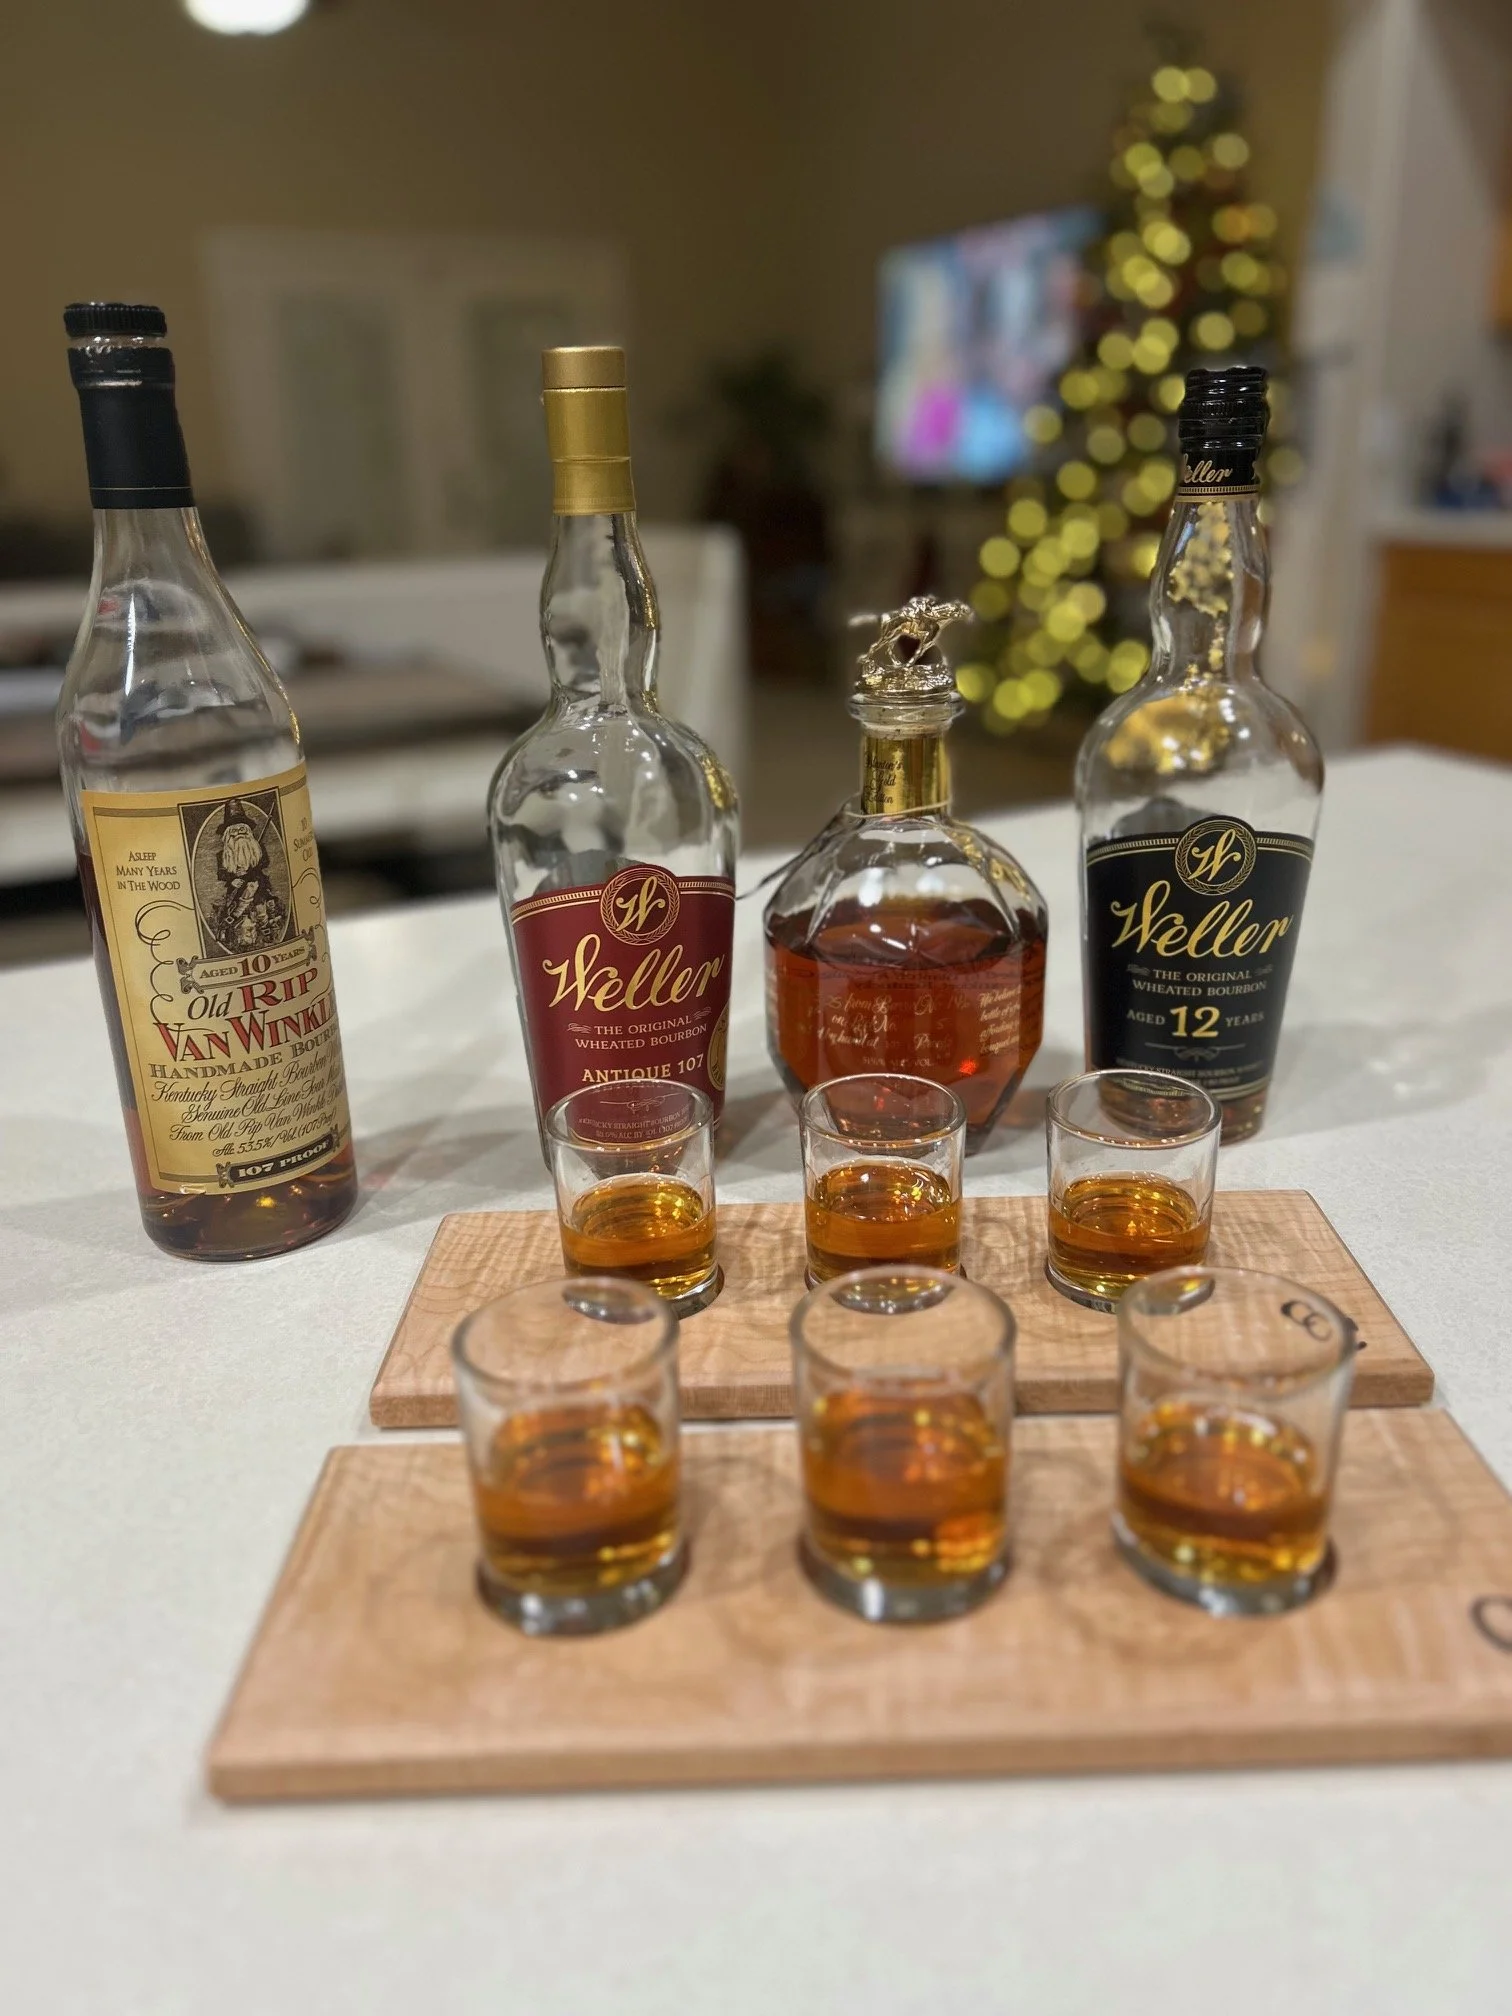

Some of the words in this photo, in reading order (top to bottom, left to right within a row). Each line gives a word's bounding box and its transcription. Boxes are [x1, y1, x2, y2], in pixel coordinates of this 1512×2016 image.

[1182, 453, 1233, 483] eller
[116, 865, 144, 877] MANY
[146, 865, 178, 877] YEARS
[128, 851, 157, 862] ASLEEP
[148, 880, 181, 891] WOOD
[1110, 879, 1294, 959] Weller
[200, 966, 239, 979] AGED
[237, 953, 272, 978] 10
[270, 946, 306, 965] YEARS
[542, 933, 725, 1012] Weller
[1152, 969, 1181, 982] THE
[1186, 969, 1252, 983] ORIGINAL
[187, 991, 233, 1020] Old
[237, 968, 318, 1013] RIP
[1132, 979, 1202, 996] WHEATED
[1206, 980, 1267, 997] BOURBON
[575, 1037, 646, 1050] WHEATED
[650, 1023, 708, 1047] BOURBON
[594, 1025, 623, 1035] THE
[628, 1015, 692, 1034] ORIGINAL
[1126, 1009, 1165, 1025] AGED
[1169, 1005, 1221, 1038] 12
[1225, 1011, 1265, 1027] YEARS
[152, 1022, 231, 1062] VAN
[148, 1052, 282, 1079] HANDMADE
[151, 1081, 217, 1111] Kentucky
[220, 1069, 279, 1101] Straight
[279, 1051, 326, 1087] Bourbon
[581, 1063, 671, 1082] ANTIQUE
[678, 1053, 704, 1074] 107
[181, 1104, 241, 1123] Genuine
[242, 1092, 270, 1117] Old
[265, 1087, 300, 1111] Line
[169, 1123, 204, 1141] From
[208, 1122, 235, 1141] Old
[234, 1118, 263, 1141] Rip
[264, 1109, 291, 1131] Van
[238, 1162, 274, 1178] 107
[280, 1140, 329, 1168] PROOF
